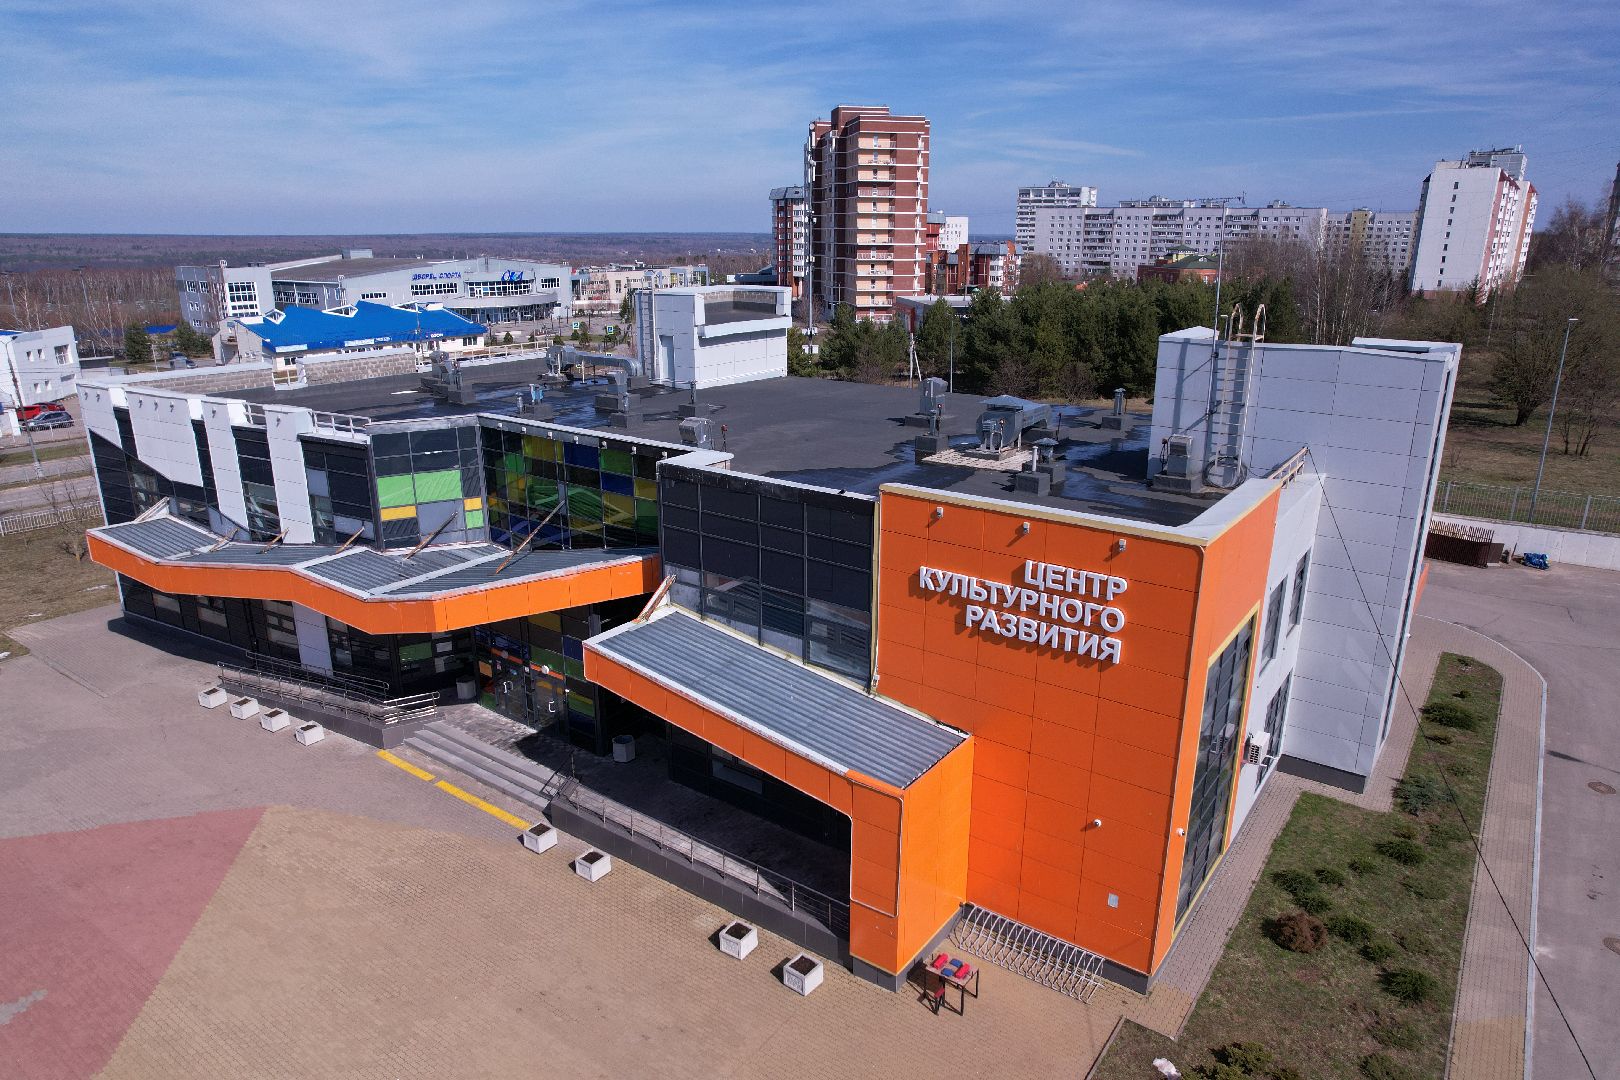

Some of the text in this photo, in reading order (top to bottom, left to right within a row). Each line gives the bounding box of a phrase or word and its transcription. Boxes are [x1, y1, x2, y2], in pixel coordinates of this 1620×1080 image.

[919, 566, 1125, 632] КУЛЬТУРНОГО
[1024, 560, 1128, 601] ЦЕНТР
[965, 605, 1122, 664] РАЗВИТИЯ
